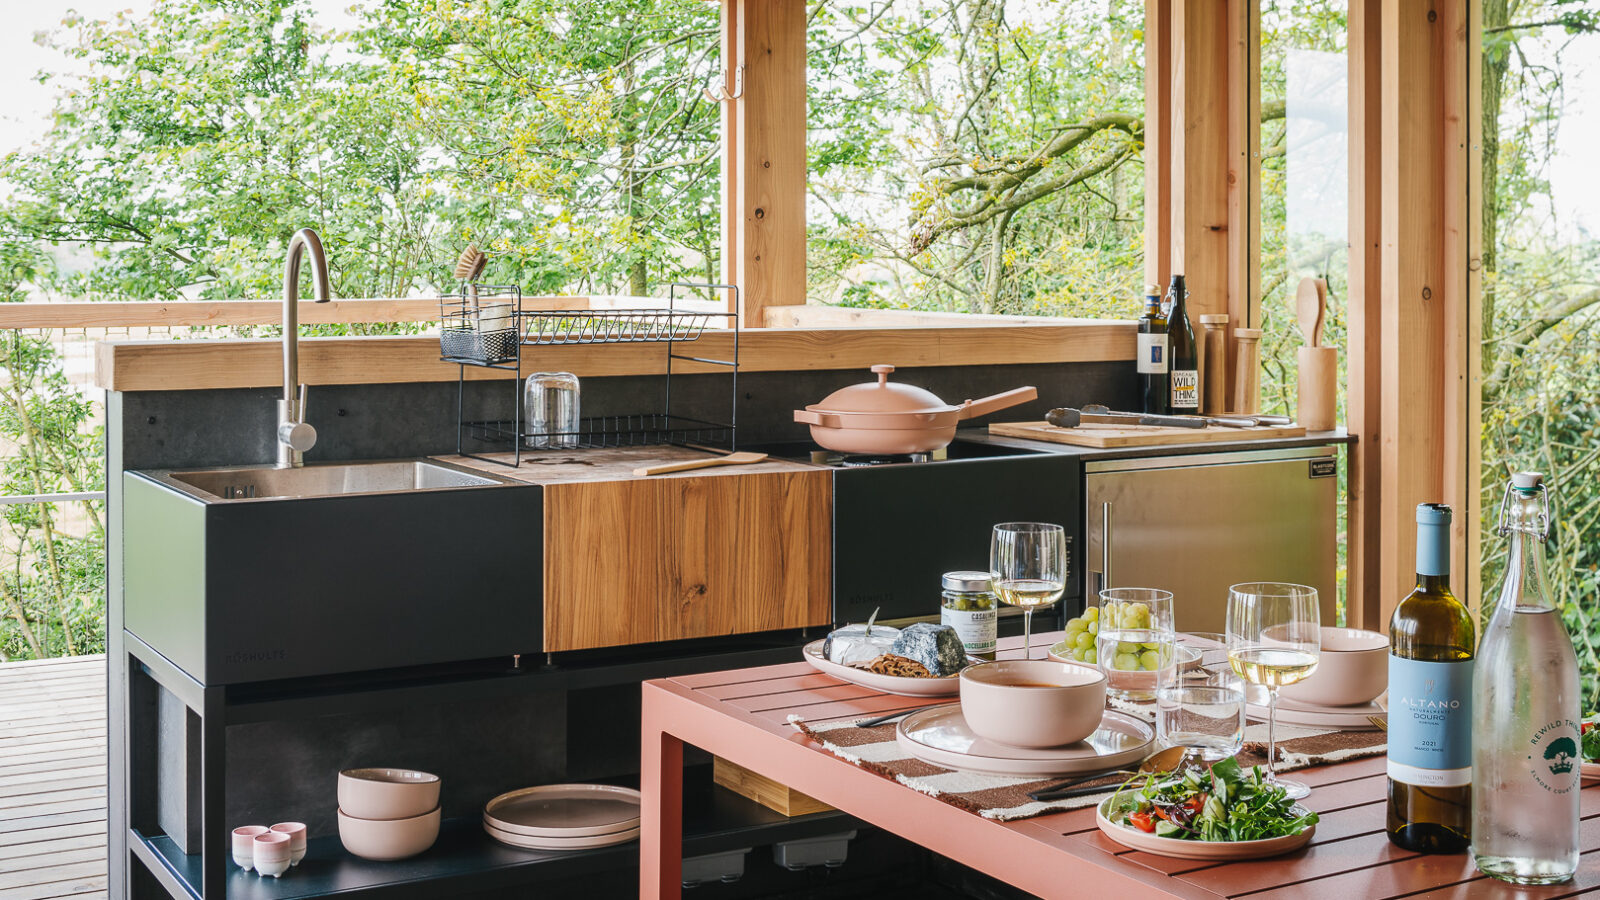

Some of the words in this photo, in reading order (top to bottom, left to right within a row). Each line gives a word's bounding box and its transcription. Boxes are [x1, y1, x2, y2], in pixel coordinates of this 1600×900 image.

[1173, 377, 1196, 386] WILD
[1173, 389, 1196, 399] THING
[1400, 697, 1460, 709] ALTANO
[1530, 719, 1562, 745] REWILD
